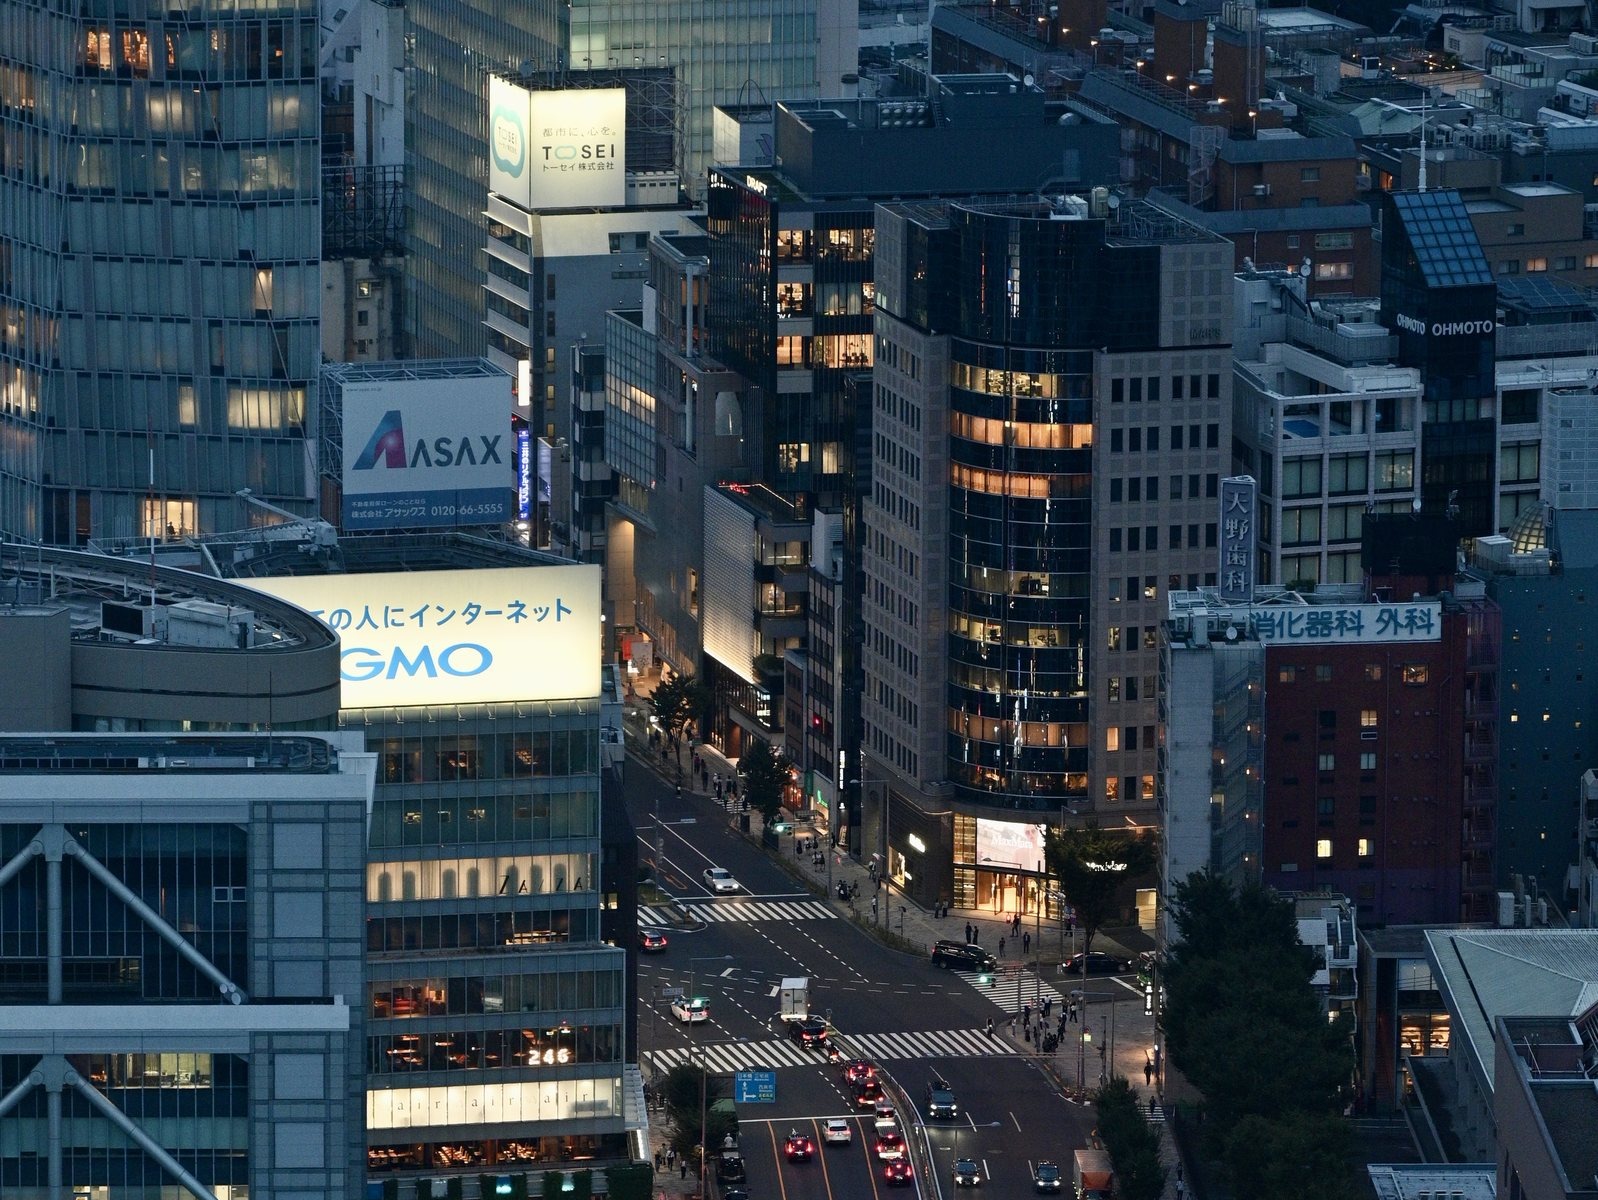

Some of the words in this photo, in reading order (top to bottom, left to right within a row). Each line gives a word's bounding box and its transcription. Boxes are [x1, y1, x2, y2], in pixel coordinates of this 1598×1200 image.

[542, 126, 616, 138] 都市に、心を。
[542, 143, 615, 160] TOSEI
[746, 174, 768, 196] DRAFT
[1397, 313, 1426, 335] OHMOTO
[1432, 320, 1493, 336] OHMOTO
[410, 434, 503, 468] ASAX
[431, 503, 503, 516] 0120-66-5555
[1224, 491, 1249, 593] 天野歯科
[310, 598, 572, 630] の人にインターネット
[1375, 607, 1434, 636] 外科
[340, 643, 493, 681] GMO
